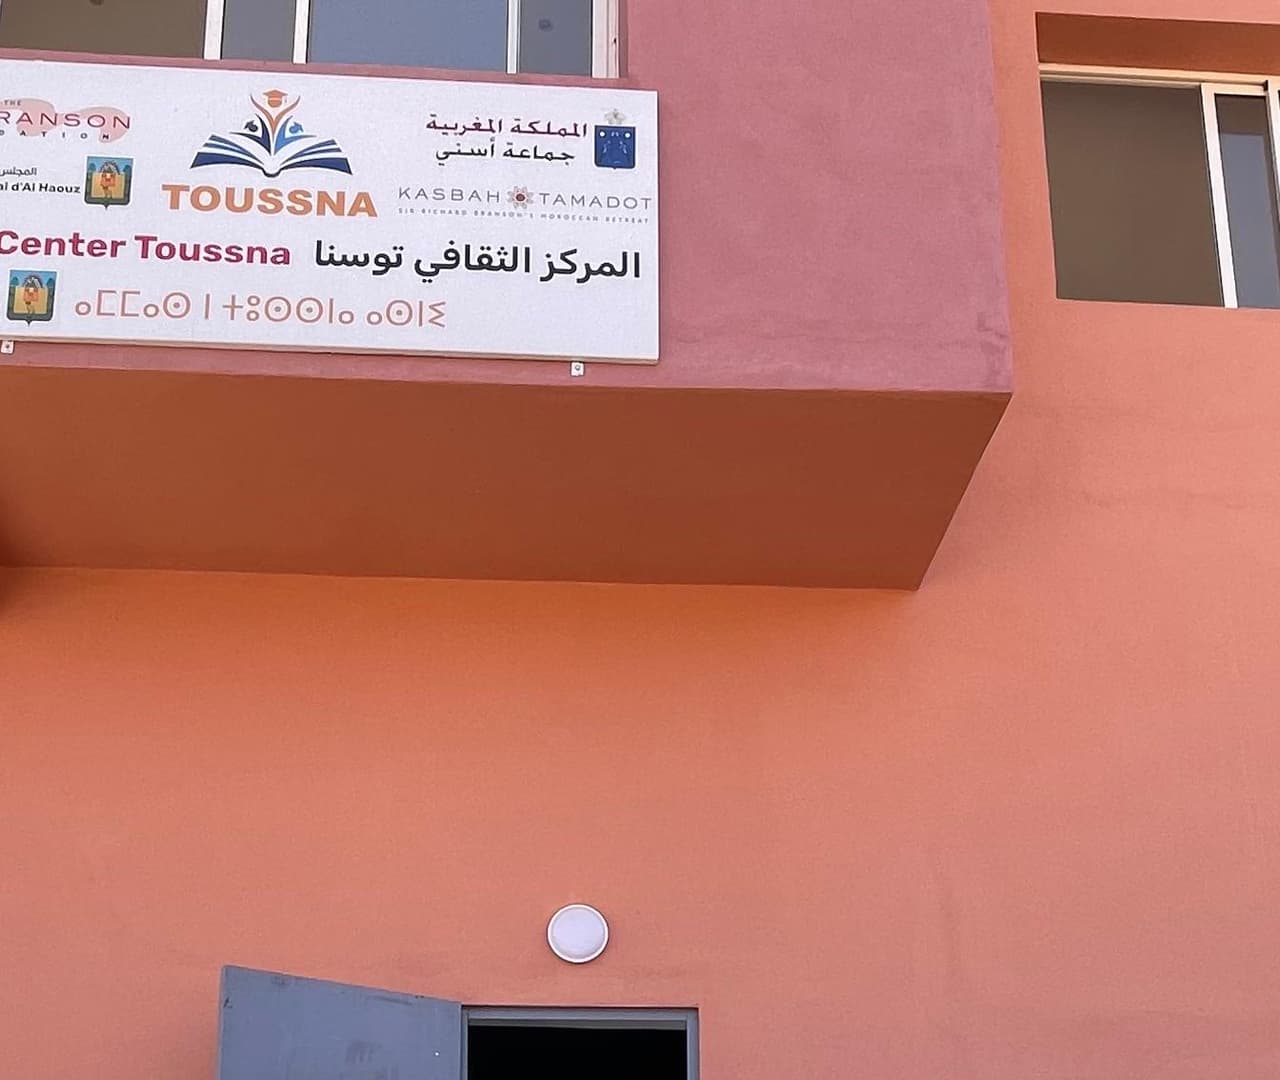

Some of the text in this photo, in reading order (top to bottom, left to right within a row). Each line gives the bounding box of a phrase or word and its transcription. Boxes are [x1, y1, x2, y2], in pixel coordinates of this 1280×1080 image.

[426, 114, 588, 138] المملكة المغربية
[435, 137, 575, 166] جماعة أسني
[40, 183, 81, 194] Haouz
[162, 184, 378, 218] TOUSSNA
[398, 187, 652, 210] KASBAH TAMADOT
[134, 235, 290, 265] Toussna
[315, 240, 641, 283] المركز الثقافي توسنا
